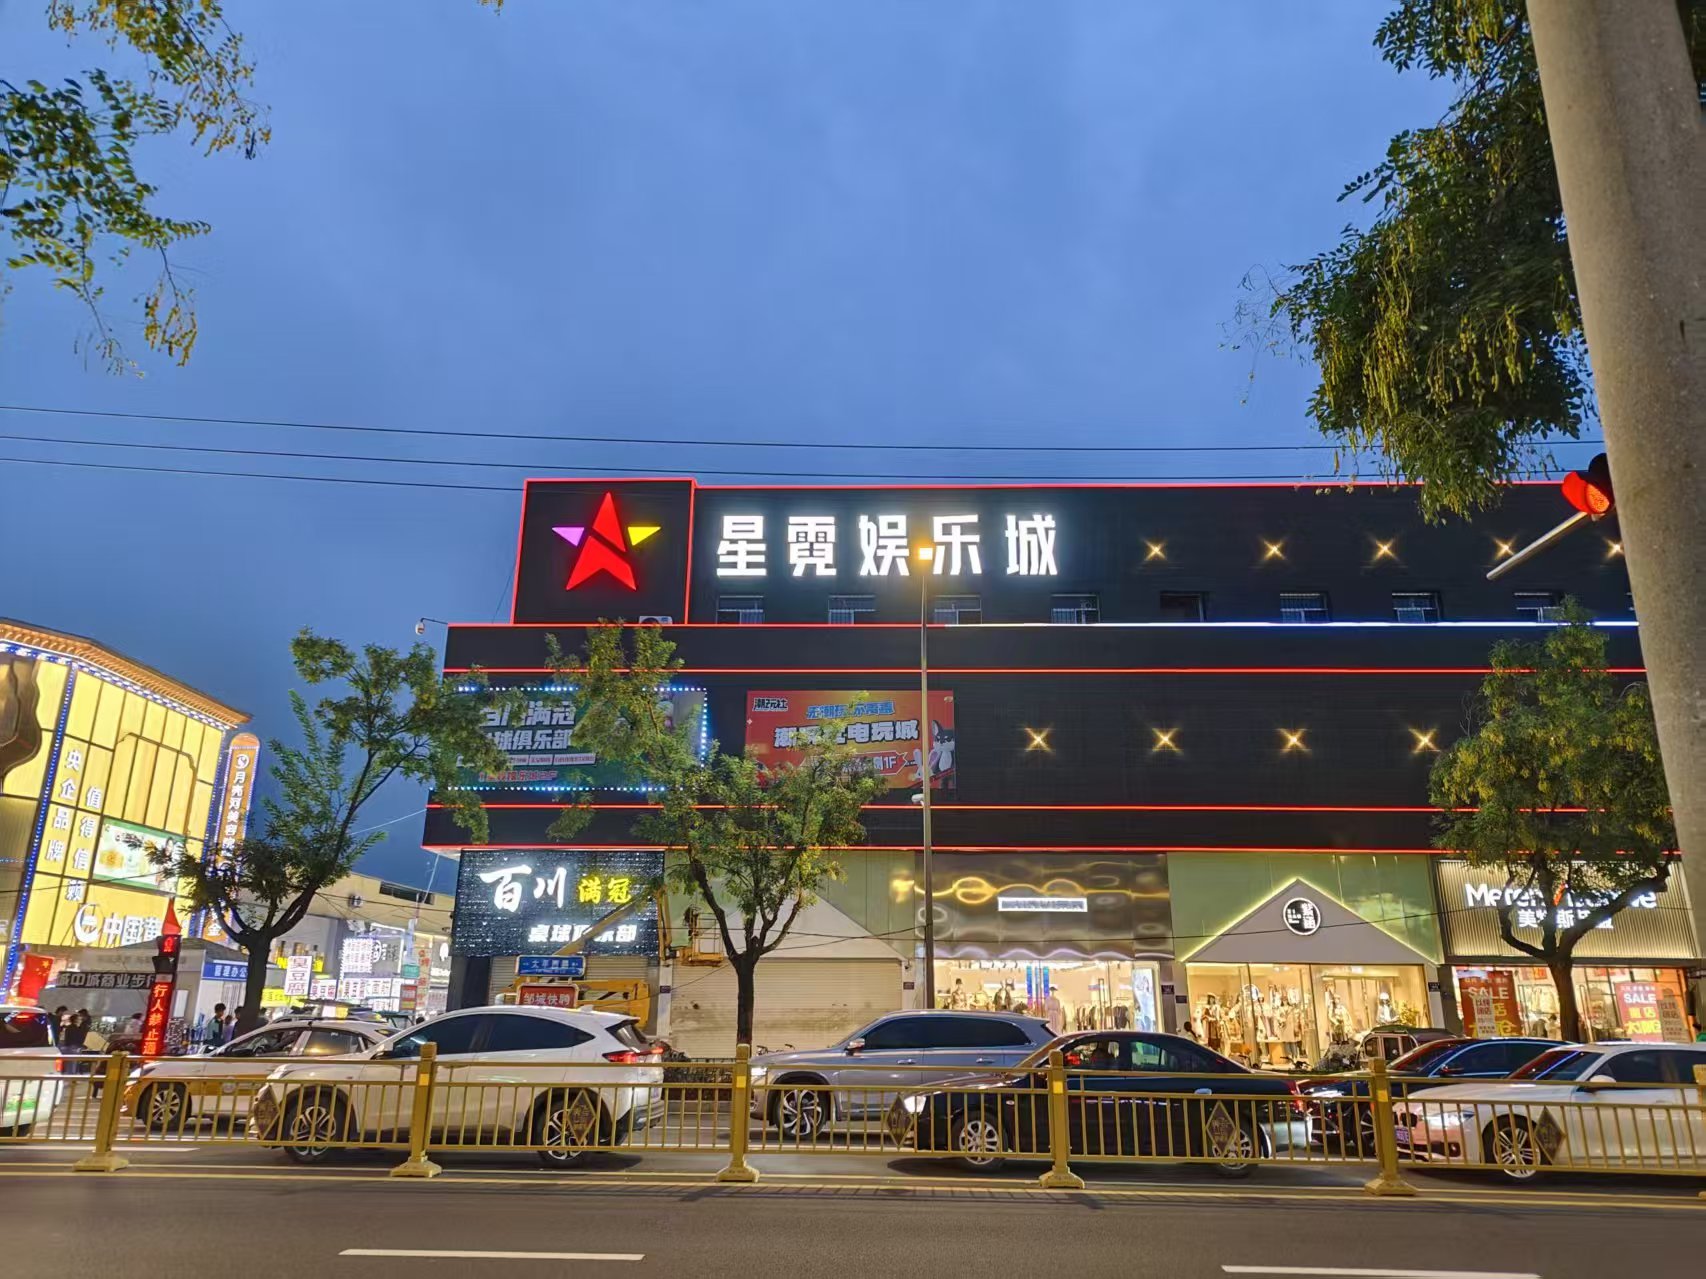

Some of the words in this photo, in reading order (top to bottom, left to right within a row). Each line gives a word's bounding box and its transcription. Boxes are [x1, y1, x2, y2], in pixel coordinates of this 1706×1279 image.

[716, 514, 1058, 577] 星霓娱乐城
[486, 729, 572, 751] 球俱乐部
[103, 912, 188, 946] 中国黄
[1624, 993, 1656, 1004] SALE
[141, 984, 168, 1056] 行人禁止通
